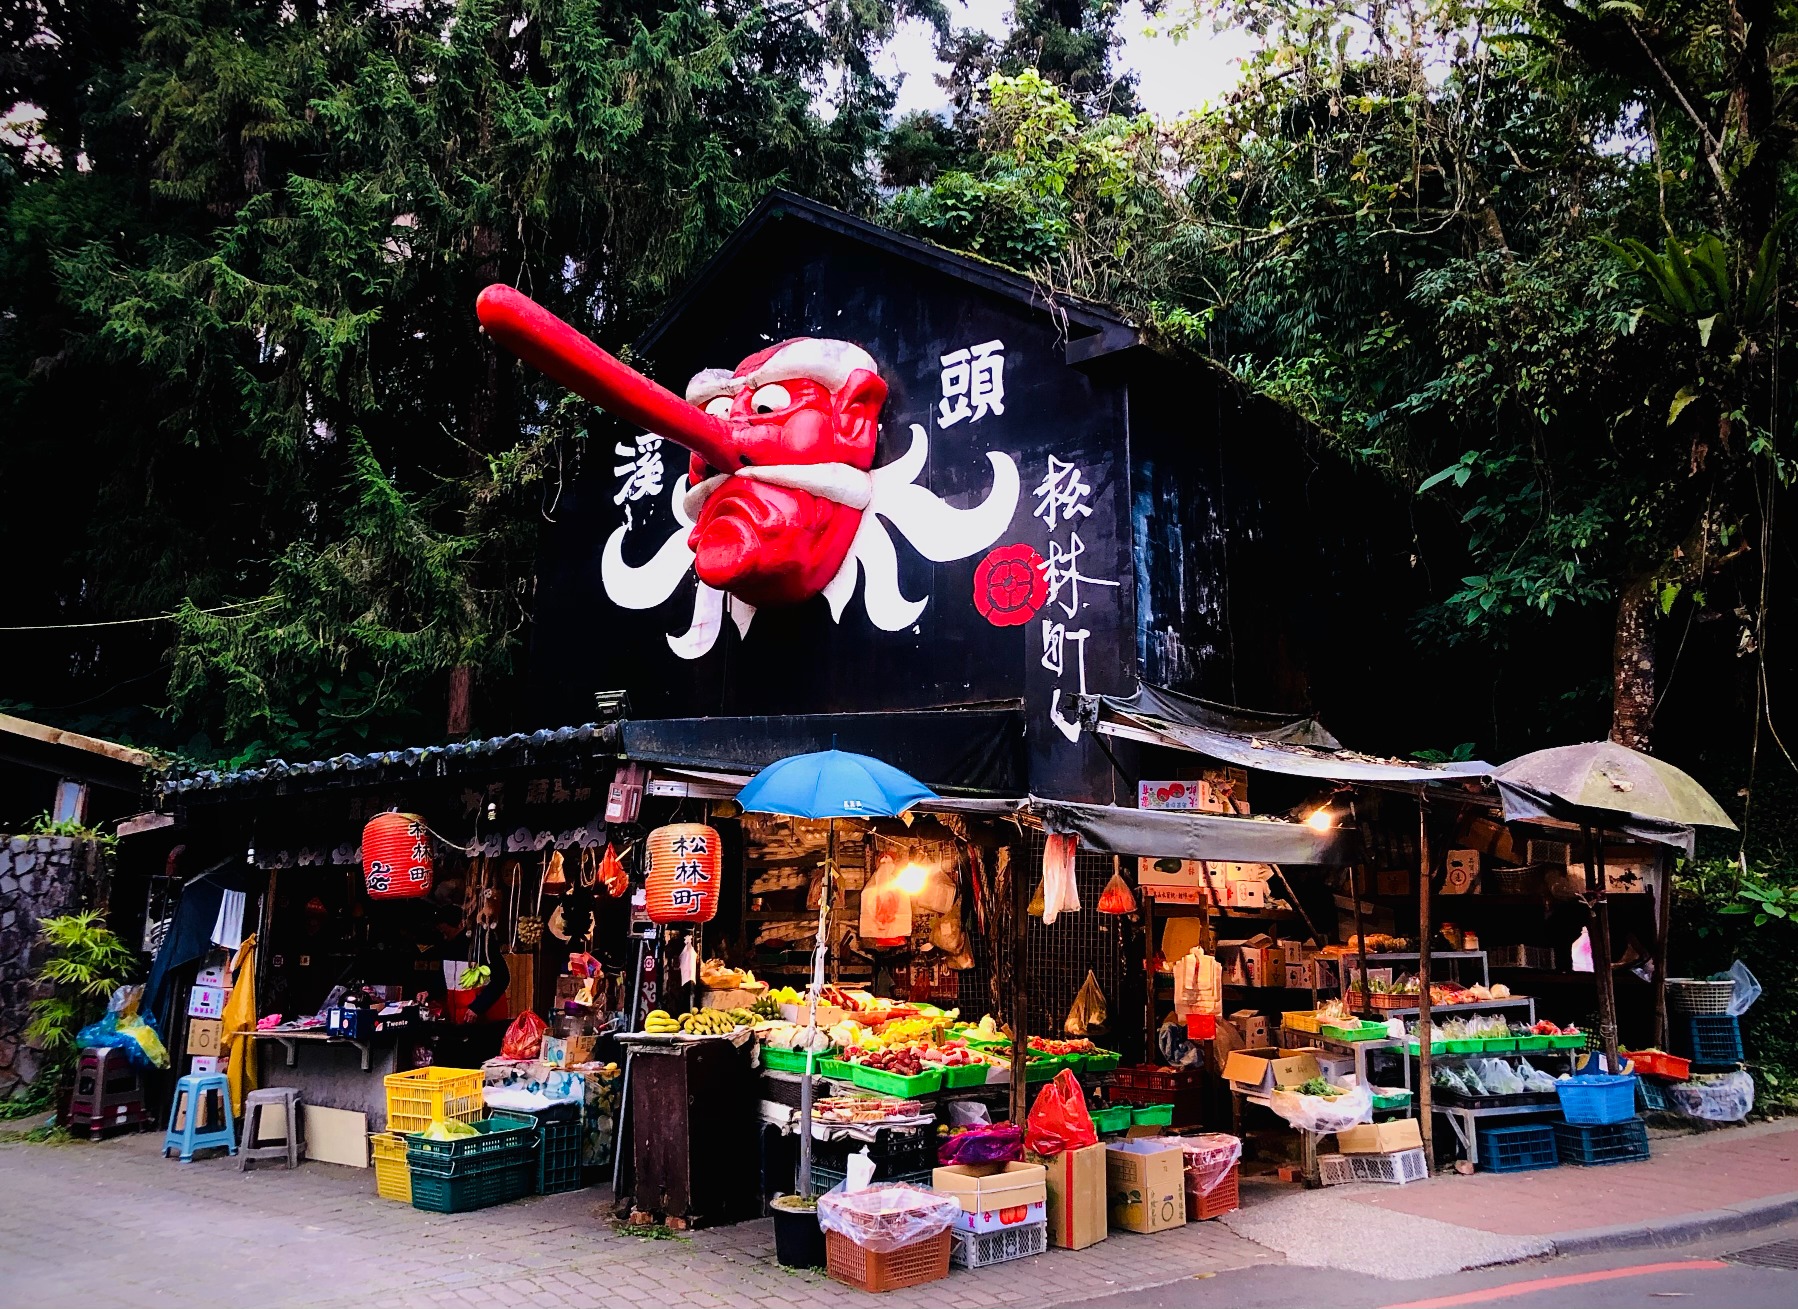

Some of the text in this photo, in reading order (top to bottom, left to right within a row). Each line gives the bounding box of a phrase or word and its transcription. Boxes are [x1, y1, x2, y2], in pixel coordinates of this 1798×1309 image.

[937, 339, 1004, 429] 頭
[613, 432, 665, 506] 溪
[671, 834, 712, 915] 松林町
